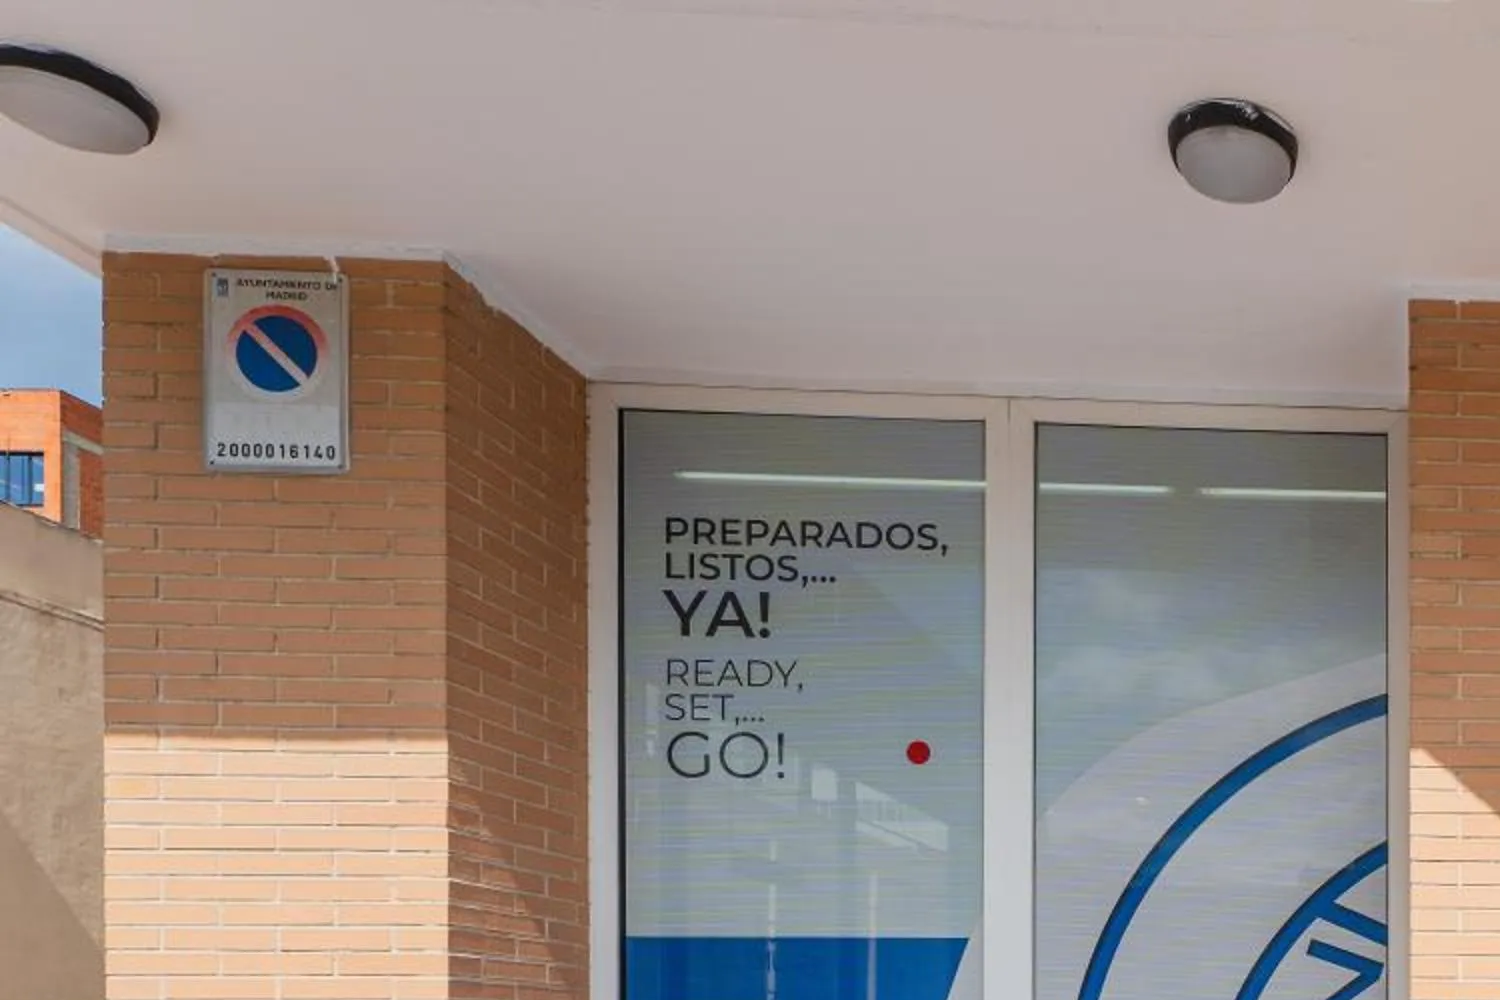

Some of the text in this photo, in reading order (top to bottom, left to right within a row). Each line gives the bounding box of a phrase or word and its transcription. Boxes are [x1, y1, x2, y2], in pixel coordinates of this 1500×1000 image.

[237, 278, 321, 291] AYUNTAMIENTO
[265, 291, 308, 301] MADRID
[217, 443, 336, 460] 2000016140
[664, 516, 949, 557] PREPARADOS,
[664, 552, 837, 589] LISTOS,...
[661, 588, 772, 639] YA!
[666, 658, 804, 693] READY,
[664, 693, 765, 726] SET,...
[666, 731, 786, 779] GO!
